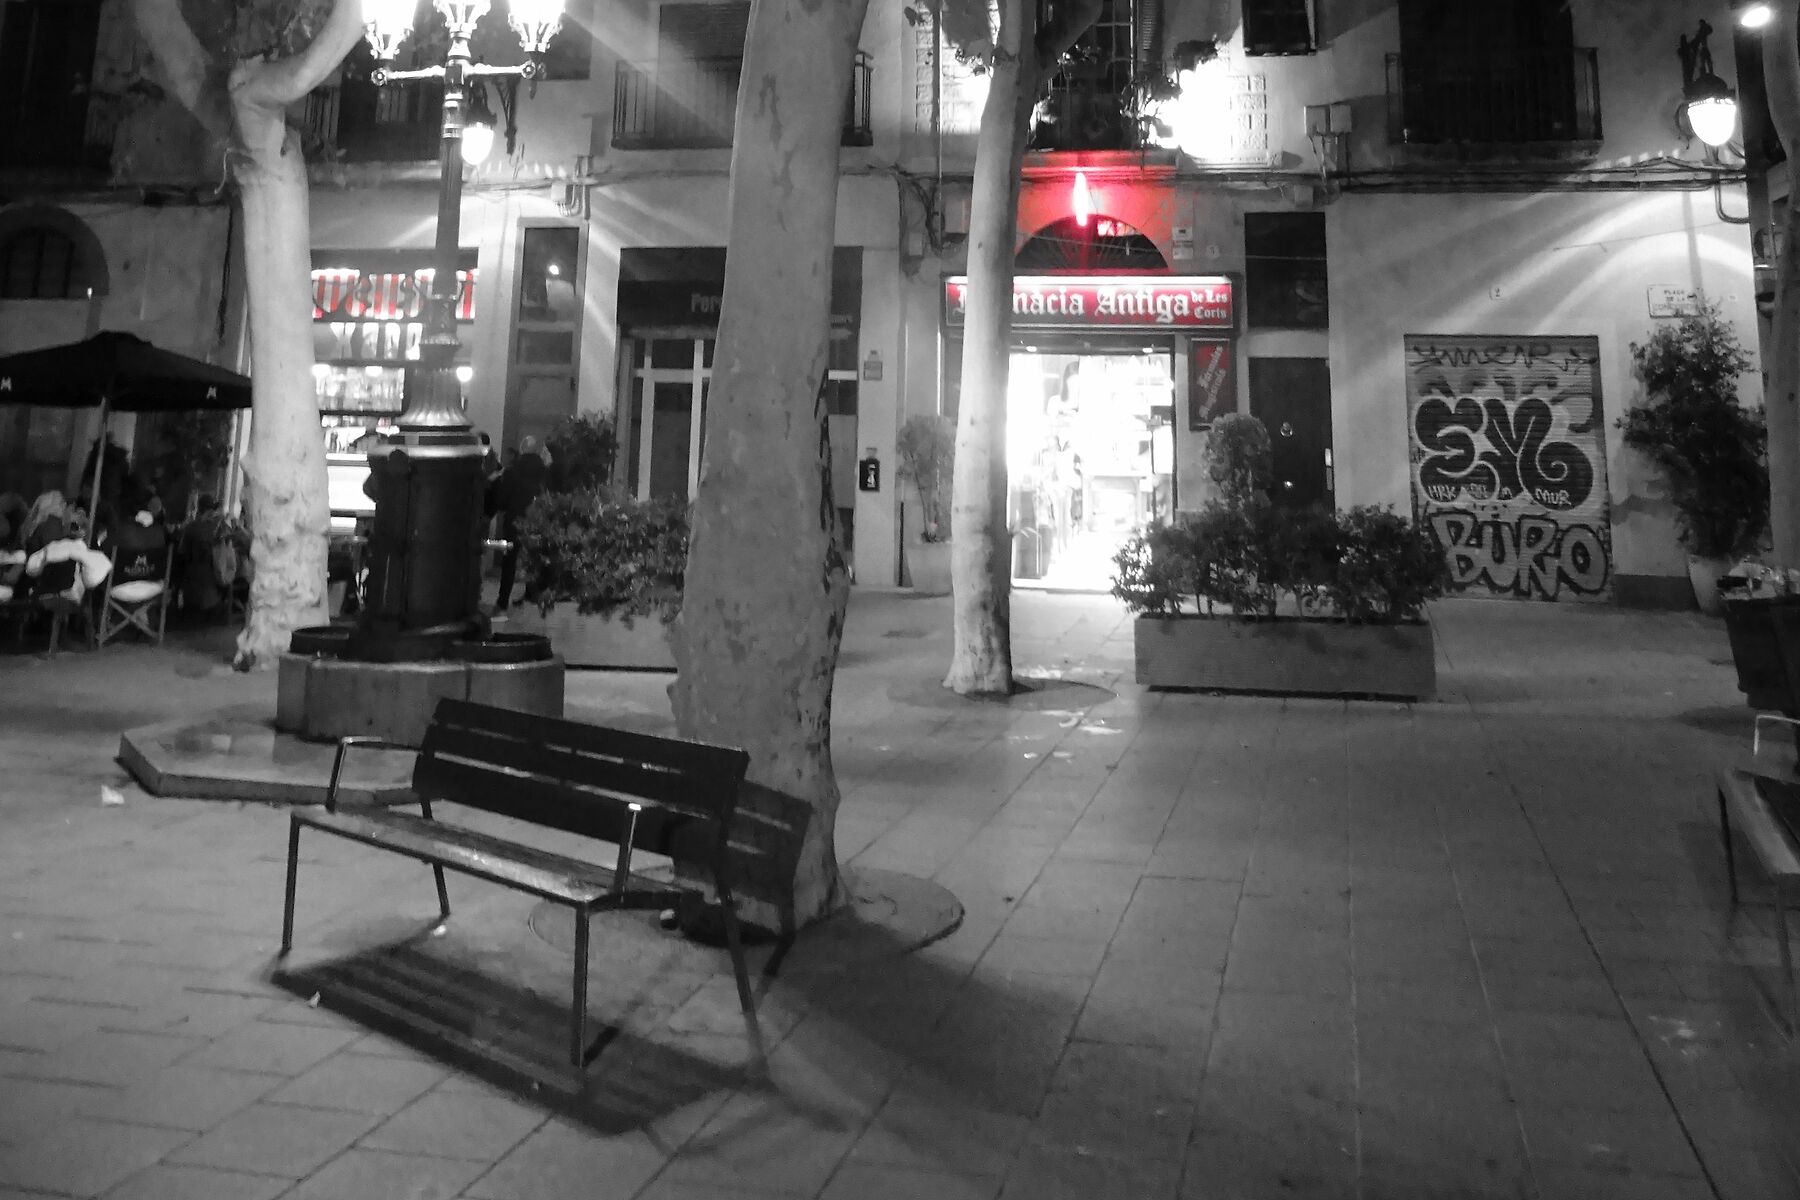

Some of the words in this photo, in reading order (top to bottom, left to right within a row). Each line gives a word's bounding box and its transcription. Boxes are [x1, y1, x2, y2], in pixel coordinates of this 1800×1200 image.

[1095, 286, 1190, 322] Antiga
[1205, 288, 1228, 304] Les
[1194, 306, 1227, 320] Corts
[1430, 509, 1608, 601] BURO
